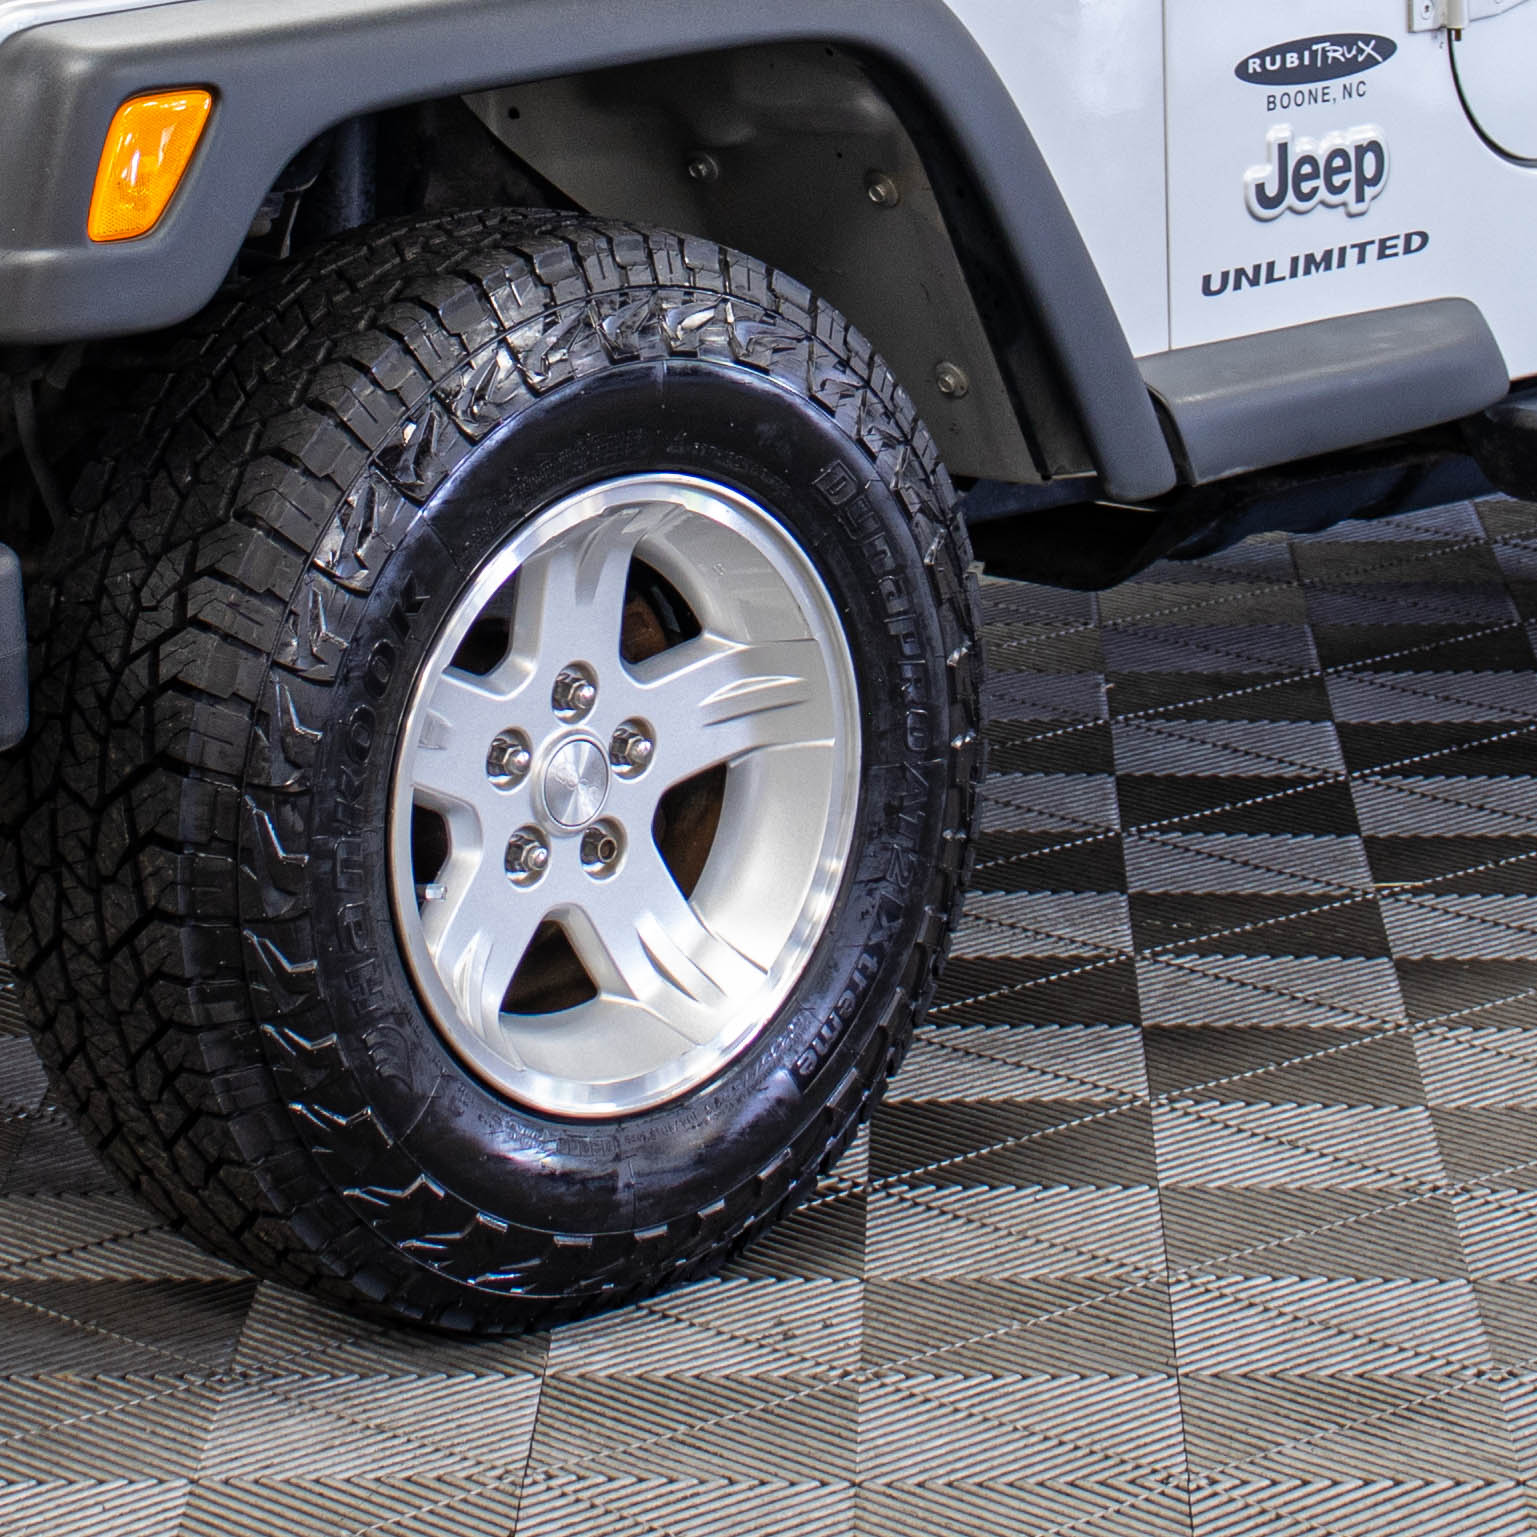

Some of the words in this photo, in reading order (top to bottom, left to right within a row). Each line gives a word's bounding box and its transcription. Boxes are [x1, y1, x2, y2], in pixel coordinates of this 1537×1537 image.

[1266, 86, 1337, 111] BOONE,
[1342, 80, 1368, 99] NC
[1253, 138, 1386, 211] Jeep
[1201, 230, 1430, 297] UNLIMITED
